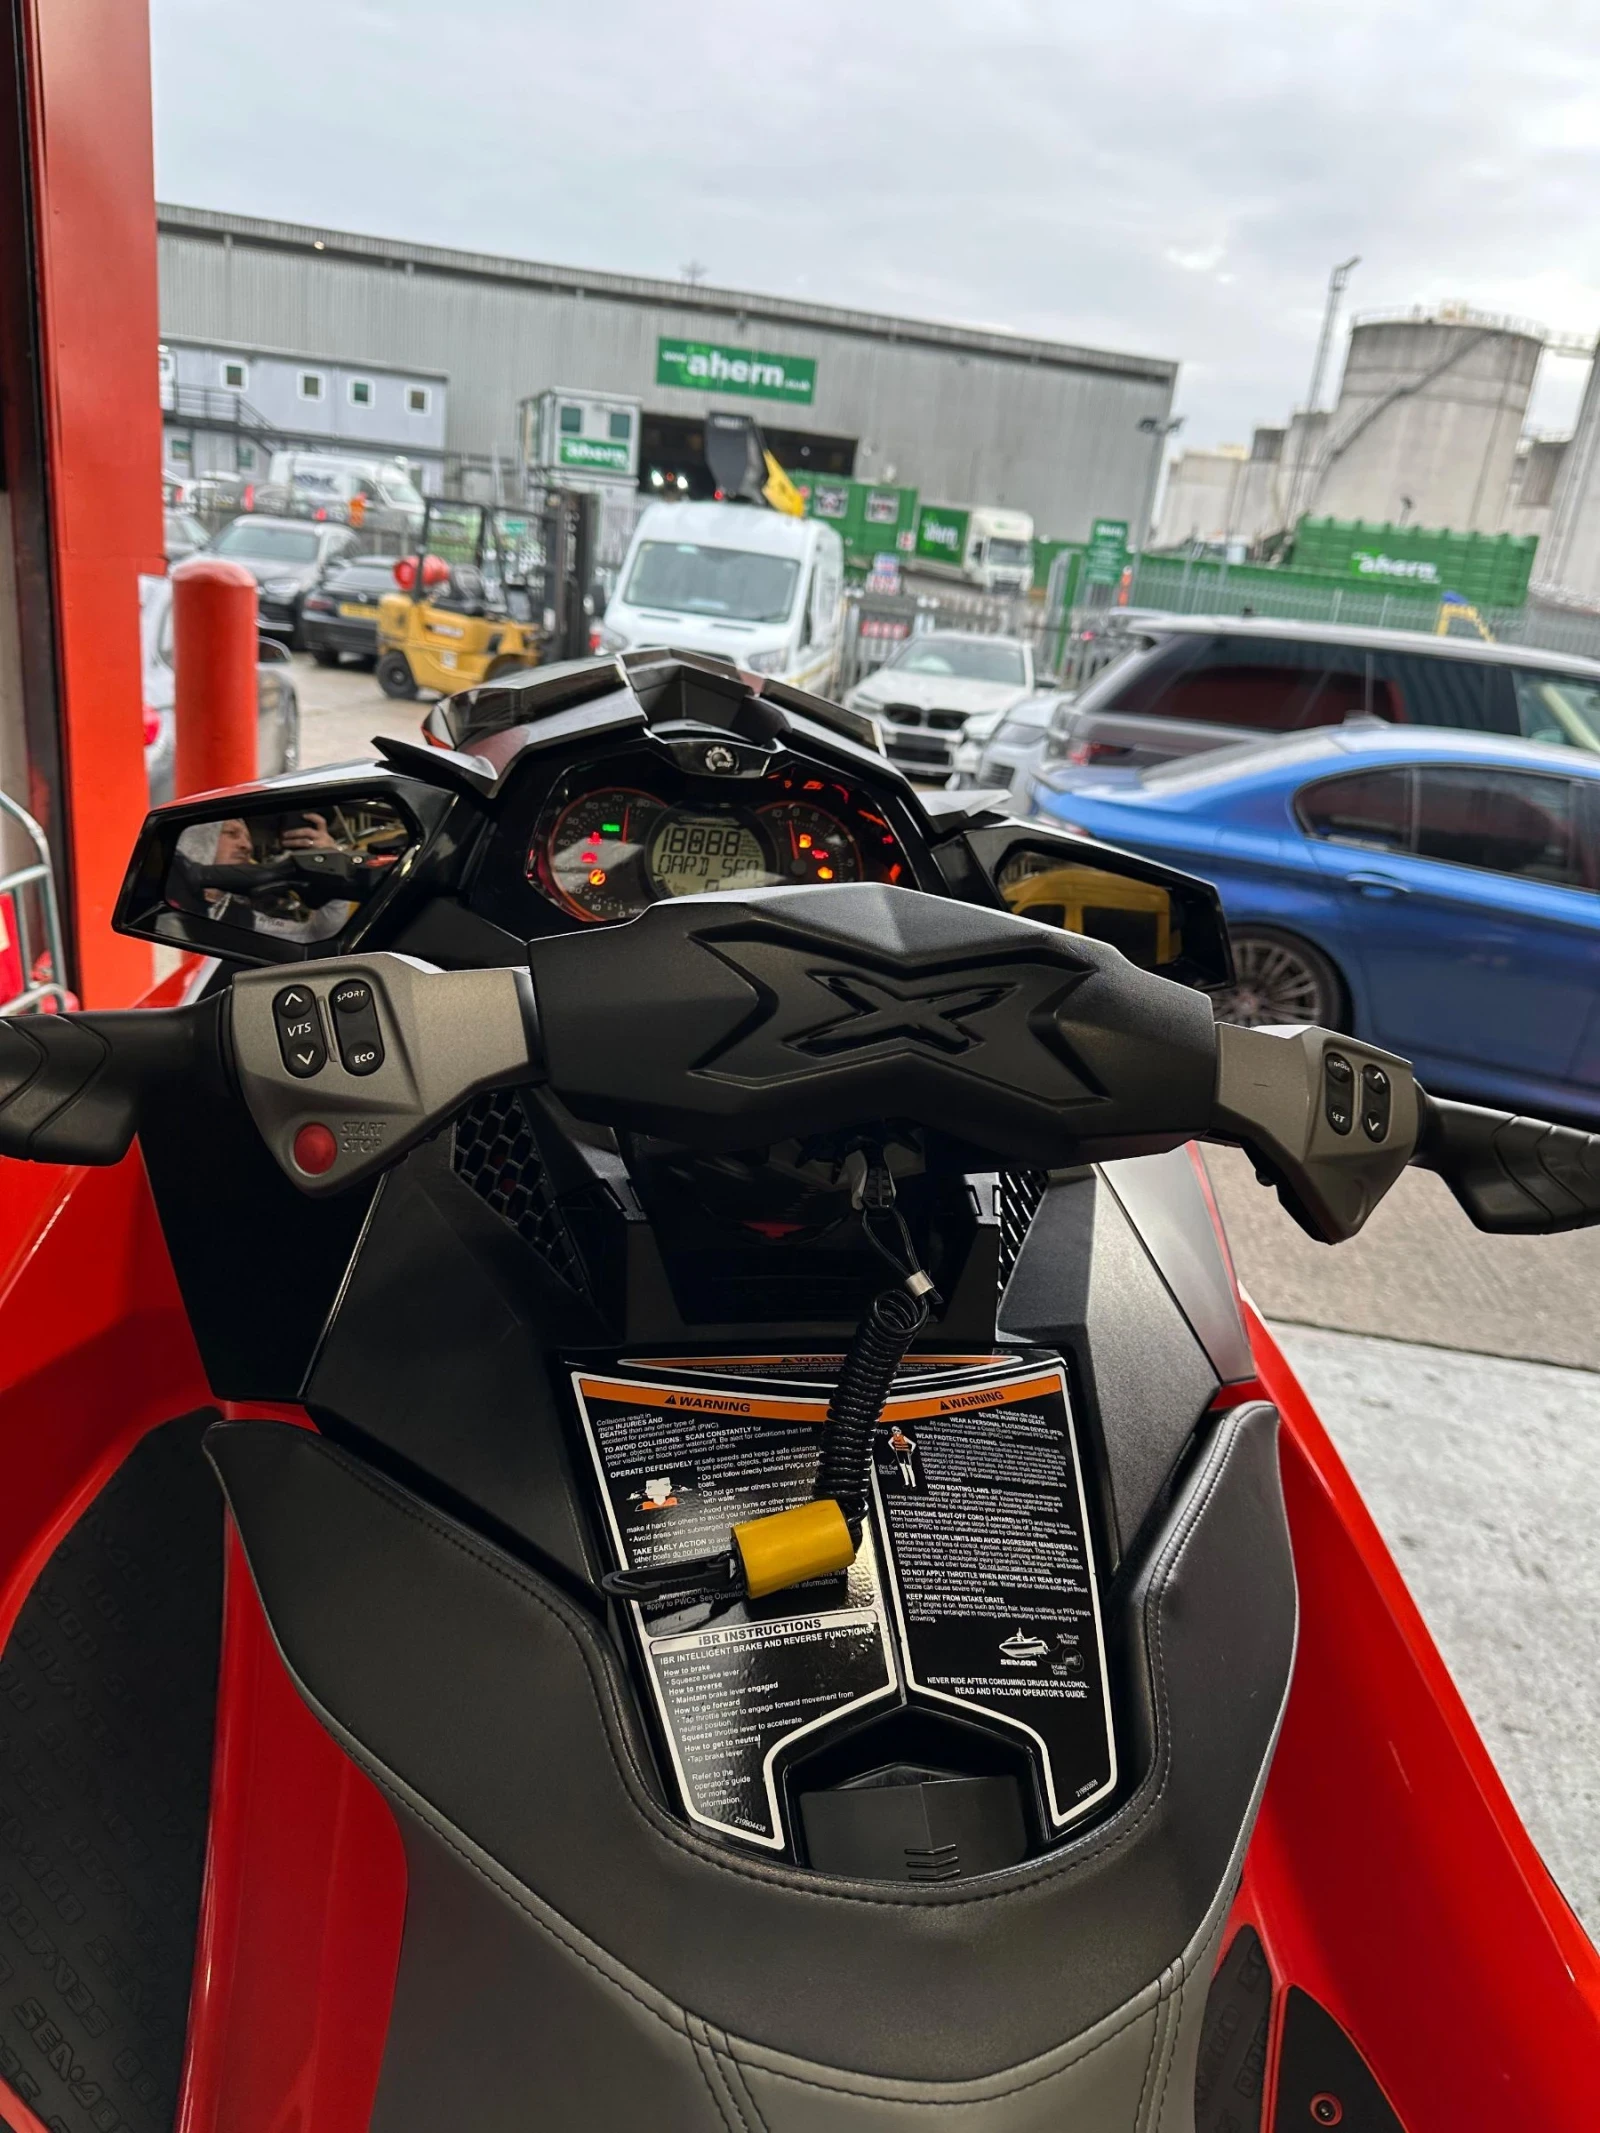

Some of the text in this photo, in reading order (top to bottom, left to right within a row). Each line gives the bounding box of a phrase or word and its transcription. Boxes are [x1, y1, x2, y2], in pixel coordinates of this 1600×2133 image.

[687, 350, 785, 388] ahern
[337, 989, 365, 1002] SPORT
[287, 1022, 312, 1038] VTS
[354, 1051, 375, 1064] ECO
[1332, 1112, 1345, 1123] SET
[340, 1122, 386, 1136] START
[342, 1138, 382, 1153] STOP
[679, 1396, 750, 1413] WARNING
[949, 1391, 1004, 1409] WARNING
[615, 1420, 647, 1430] INJURIES
[648, 1417, 663, 1425] AND
[600, 1430, 628, 1439] DEATHS
[615, 1443, 636, 1452] AVOID
[685, 1432, 705, 1440] SCAN
[706, 1426, 751, 1438] CONSTANTLY
[610, 1467, 644, 1478] OPERATE
[645, 1460, 693, 1473] DEFENSIVELY
[716, 1454, 739, 1463] speeds
[914, 1510, 937, 1518] ENGINE
[910, 1532, 931, 1540] WITHIN
[633, 1539, 707, 1556] TAKE EARLY ACTION
[947, 1571, 978, 1579] THROTTLE
[979, 1572, 997, 1580] WHEN
[997, 1573, 1022, 1581] ANYONE
[961, 1595, 983, 1603] INTAKE
[984, 1596, 1005, 1604] GRATE
[698, 1619, 822, 1646] iBR INSTRUCTIONS
[677, 1647, 731, 1662] INTELLIGENT
[733, 1641, 762, 1653] BRAKE
[764, 1639, 782, 1648] AND
[784, 1633, 822, 1645] REVERSE
[690, 1665, 711, 1673] brake
[671, 1676, 700, 1686] Squeeze
[702, 1671, 721, 1680] brake
[927, 1676, 950, 1685] NEVER
[950, 1677, 966, 1685] RIDE
[967, 1677, 988, 1685] AFTER
[988, 1678, 1027, 1687] CONSUMING
[1027, 1679, 1049, 1687] DRUGS
[1059, 1681, 1090, 1689] ALCOHOL.
[676, 1681, 779, 1704] Maintain brake lever engaged
[696, 1682, 723, 1691] reverse
[955, 1687, 1087, 1699] READ AND FOLLOW OPERATOR'S GUIDE.
[681, 1716, 694, 1724] Tap
[695, 1711, 720, 1721] throttle
[721, 1708, 738, 1717] lever
[748, 1704, 774, 1714] engage
[774, 1698, 800, 1709] forward
[802, 1692, 837, 1705] movement
[838, 1691, 854, 1699] from
[701, 1704, 711, 1712] go
[712, 1699, 741, 1709] forward
[680, 1724, 703, 1733] neutral
[682, 1731, 713, 1743] Squeeze
[714, 1727, 739, 1738] throttle
[740, 1725, 757, 1733] lever
[685, 1745, 701, 1753] How
[712, 1740, 724, 1749] get
[735, 1734, 761, 1744] neutral
[704, 1752, 724, 1760] brake
[726, 1749, 743, 1758] lever
[692, 1772, 712, 1780] Refer
[694, 1775, 751, 1791] operator's guide
[708, 1790, 727, 1798] more
